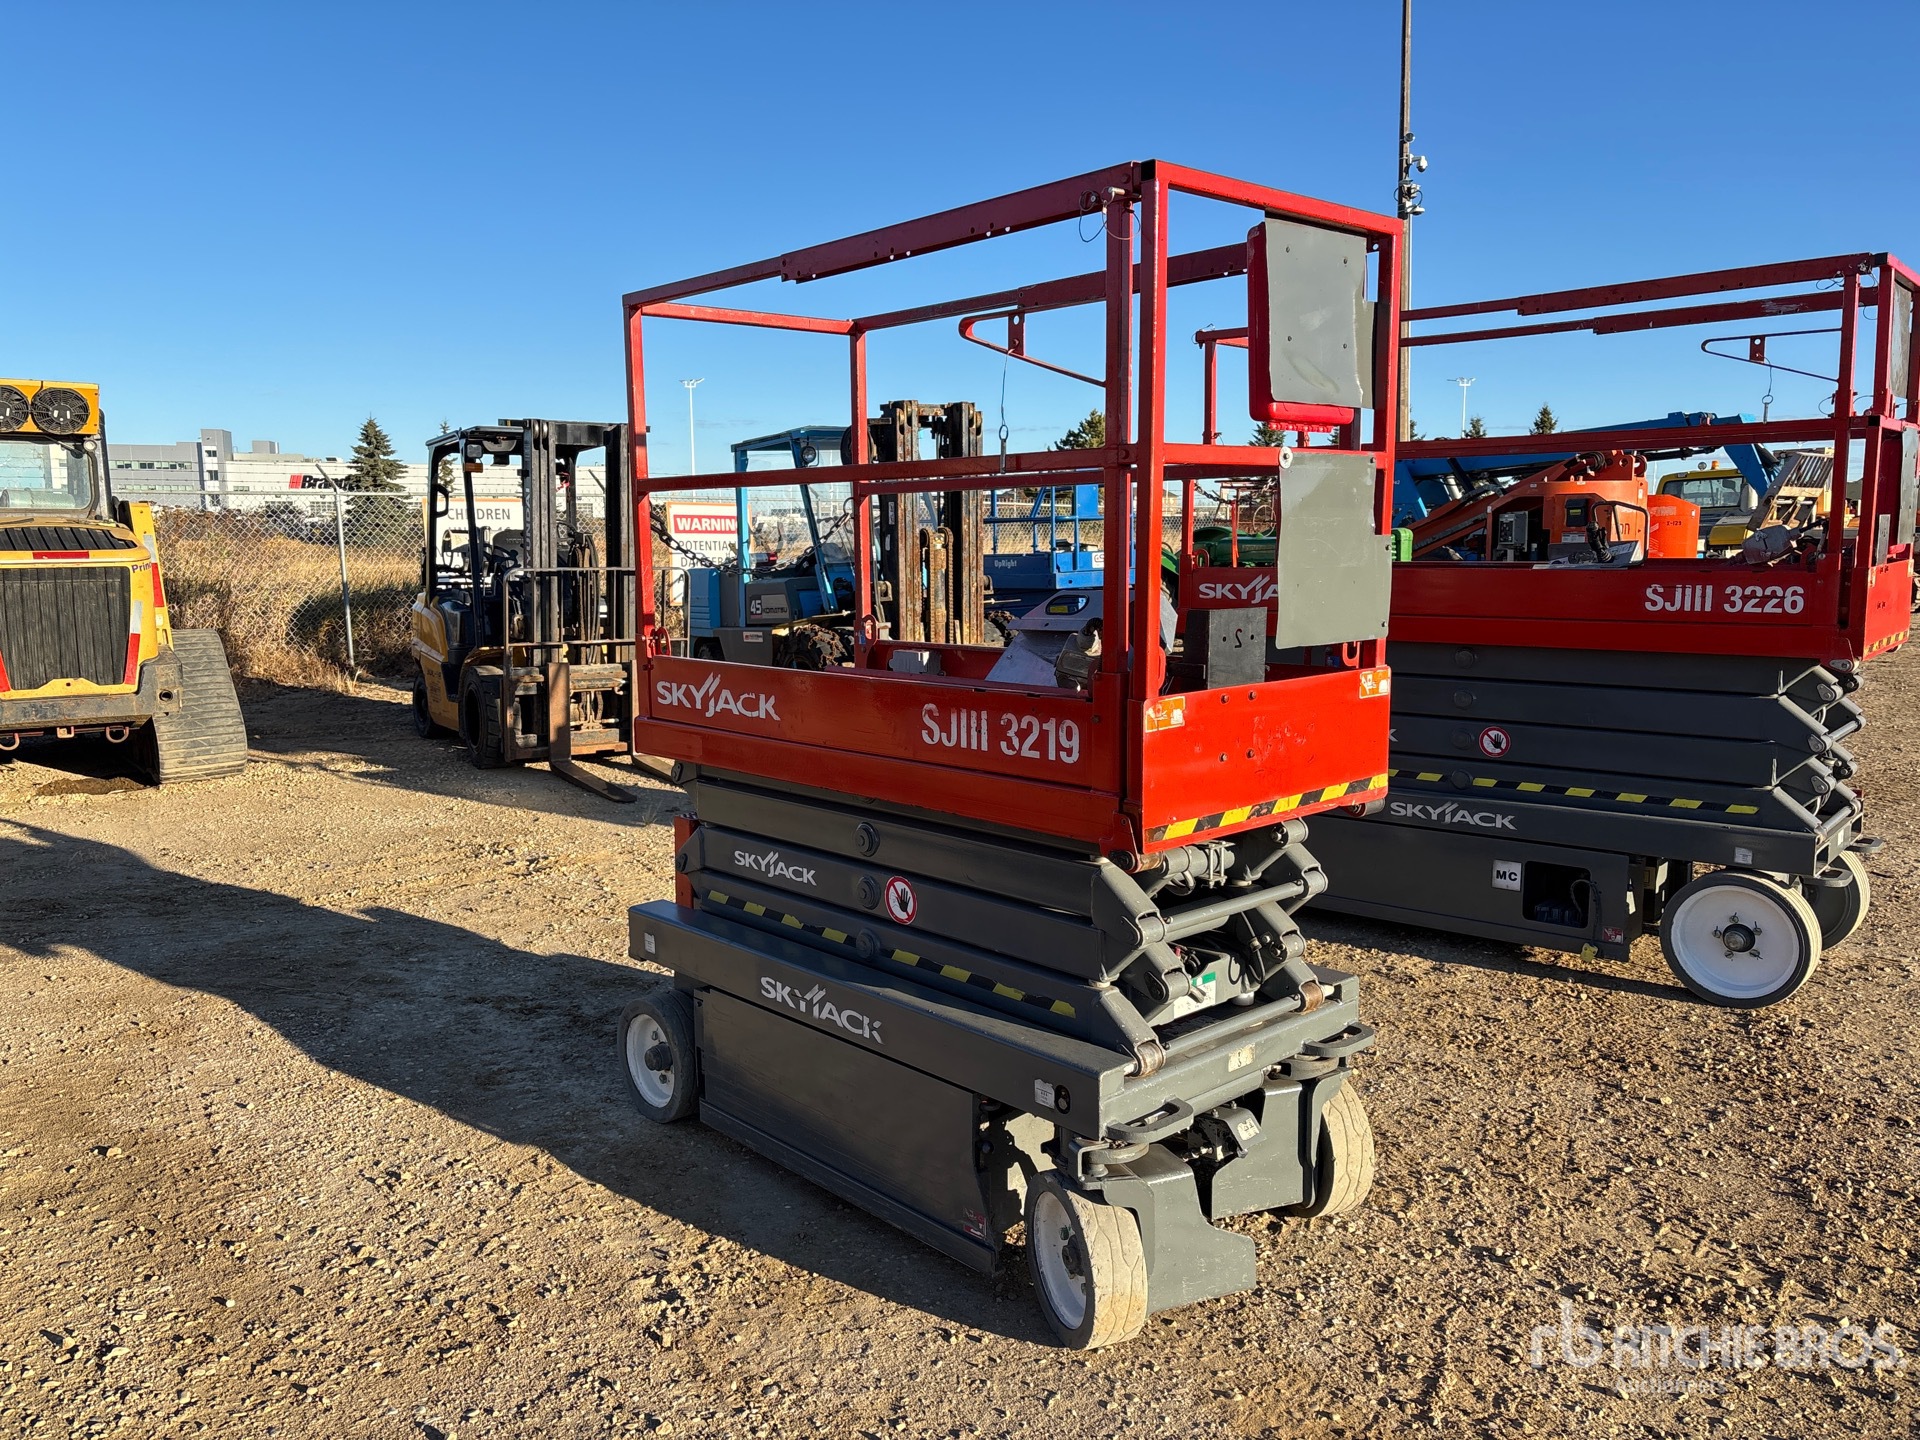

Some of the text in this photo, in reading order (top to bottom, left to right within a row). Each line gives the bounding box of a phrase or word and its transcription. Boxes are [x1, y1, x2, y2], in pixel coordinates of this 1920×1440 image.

[448, 508, 511, 520] CHDREN
[676, 517, 737, 531] WARNIN
[679, 541, 736, 551] POTENTIA
[994, 559, 1017, 569] UpRight
[1198, 574, 1279, 604] SKYJA
[1723, 585, 1805, 614] 3226
[750, 600, 762, 614] 45
[656, 672, 781, 721] SKYJACK
[1000, 712, 1080, 764] 3219
[1390, 801, 1518, 831] SKYJACK
[734, 850, 817, 886] SKYJACK
[1495, 869, 1518, 882] MC
[760, 976, 885, 1045] SKYJACK
